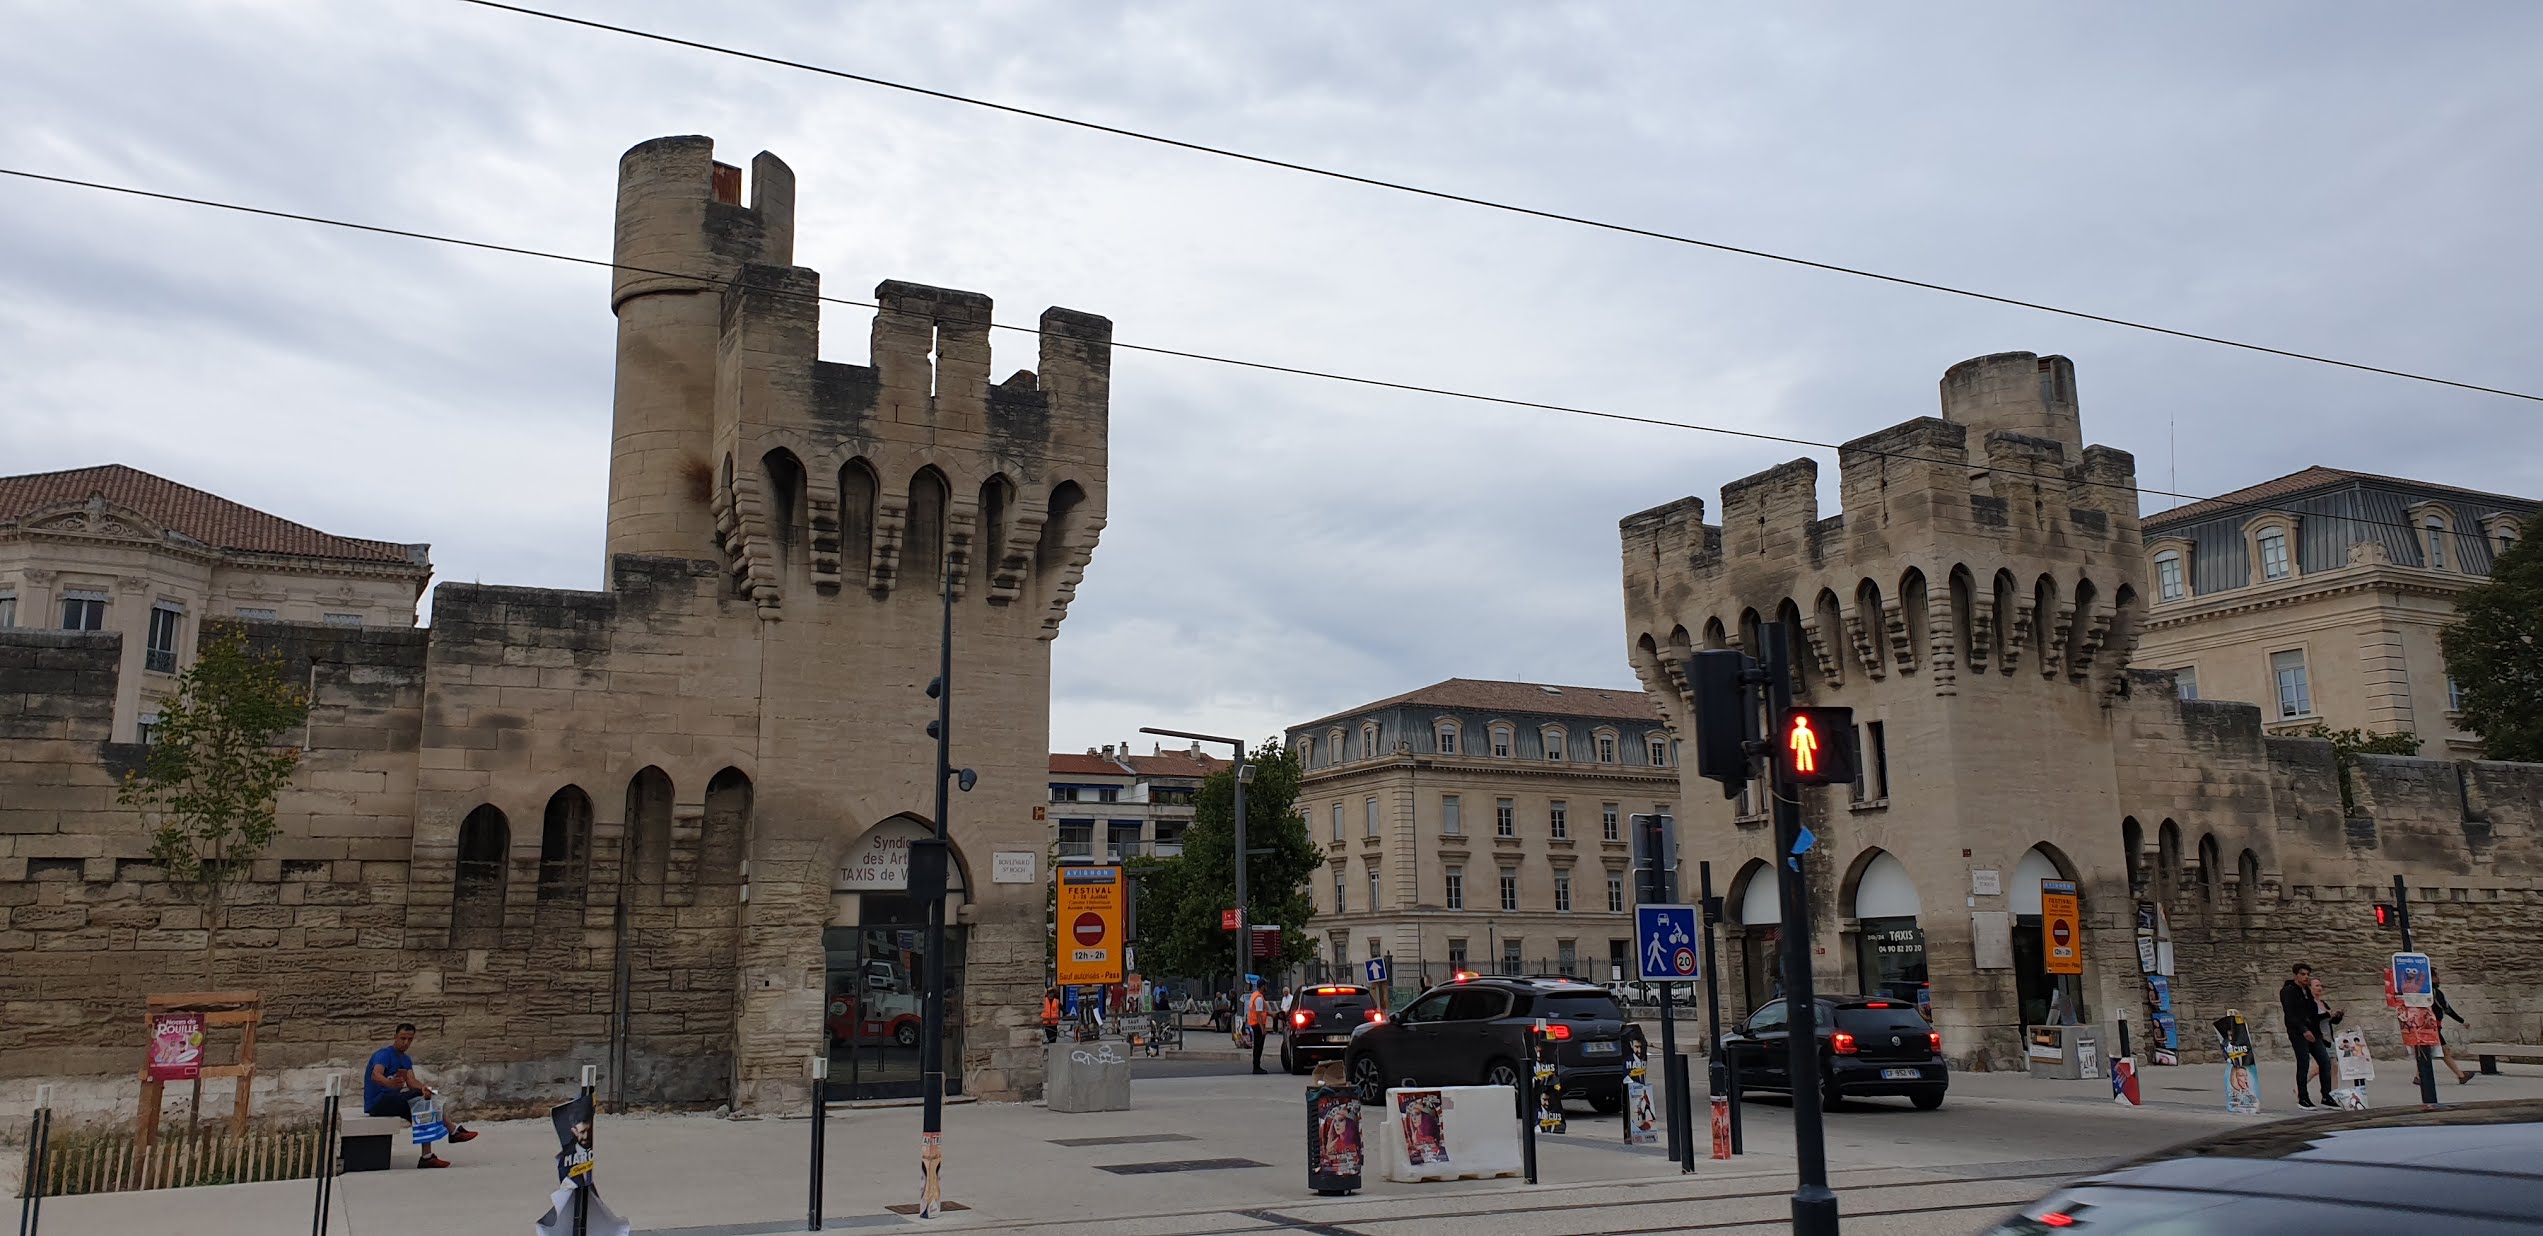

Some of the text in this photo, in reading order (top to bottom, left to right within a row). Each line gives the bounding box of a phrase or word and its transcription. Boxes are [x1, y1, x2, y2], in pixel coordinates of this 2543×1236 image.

[863, 852, 884, 865] des
[841, 868, 865, 881] TAXIS
[881, 868, 895, 881] de
[1889, 930, 1914, 941] TAXIS
[1878, 945, 1887, 953] 04
[1887, 945, 1896, 953] 90
[1896, 945, 1905, 953] 82
[1914, 944, 1922, 952] 20
[1075, 952, 1088, 960] 12h
[1095, 950, 1105, 959] 2h
[1678, 956, 1691, 967] 20
[1059, 972, 1073, 980] Sauf
[1104, 970, 1120, 979] Pass
[564, 1150, 593, 1167] MARC
